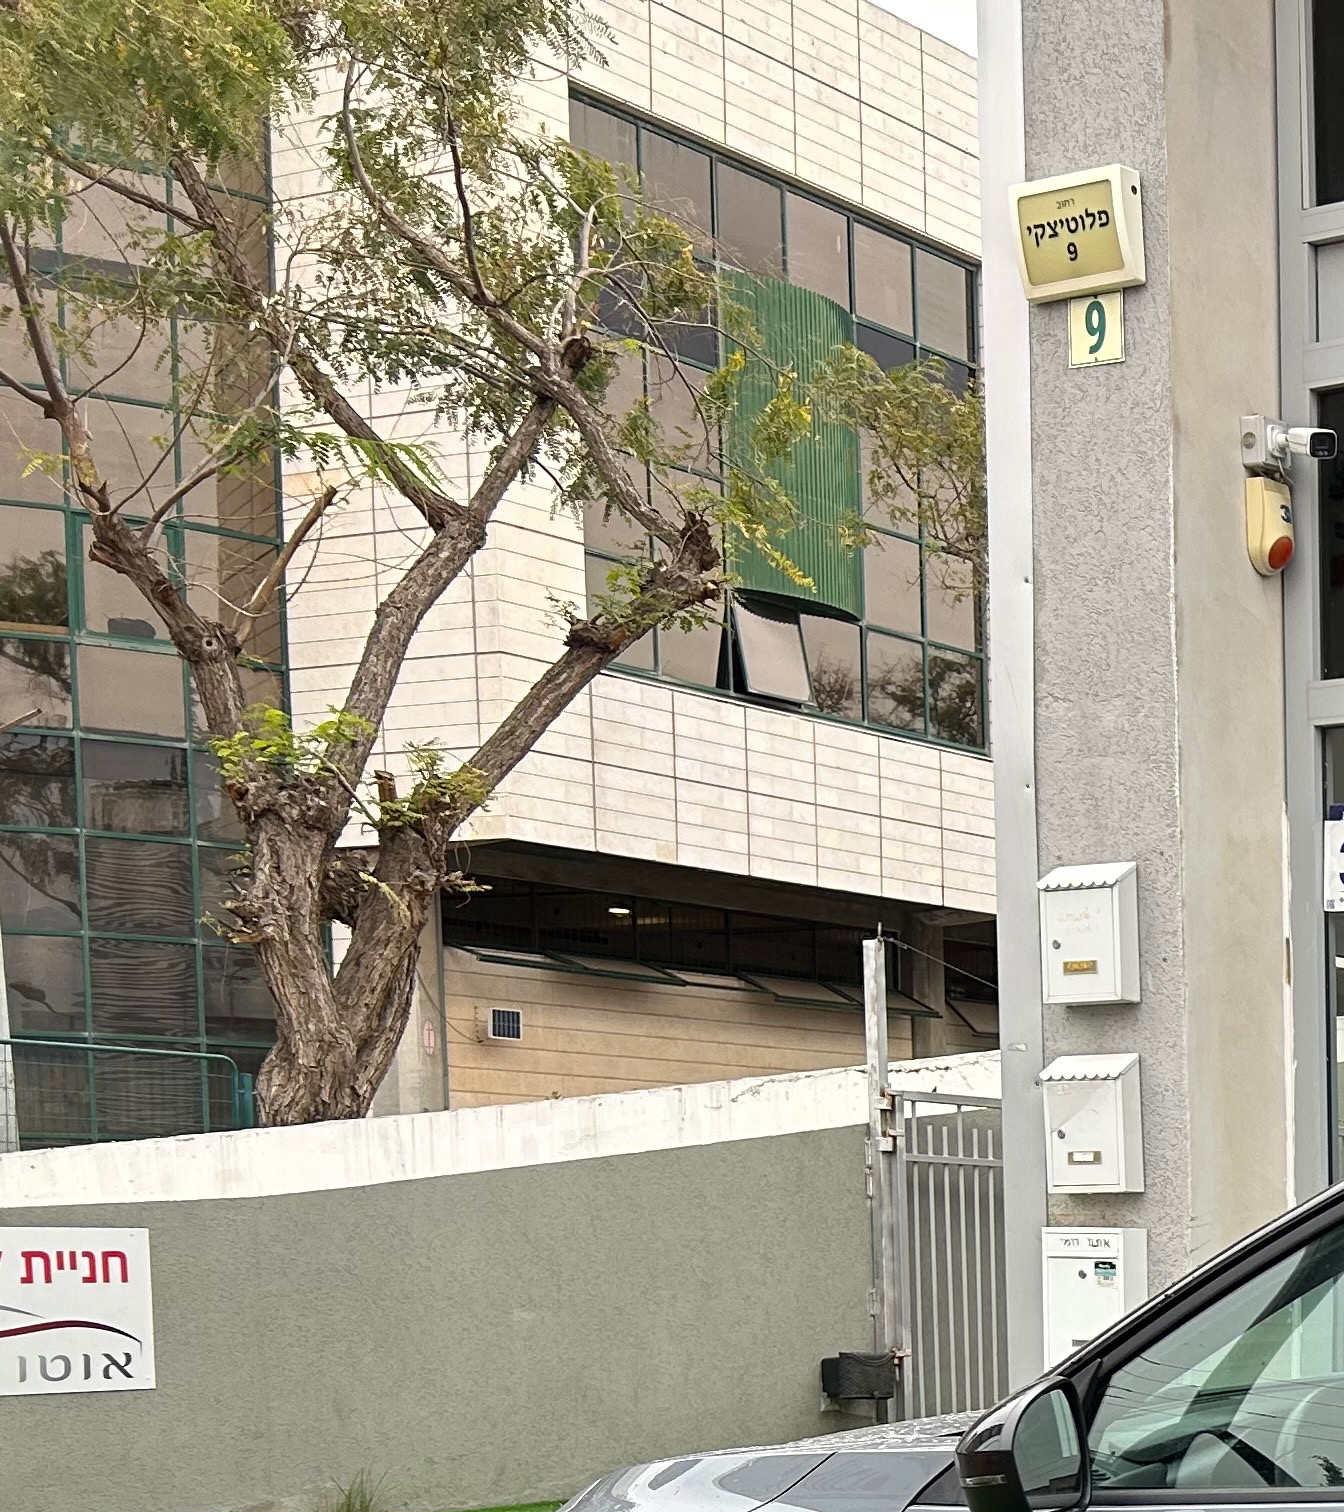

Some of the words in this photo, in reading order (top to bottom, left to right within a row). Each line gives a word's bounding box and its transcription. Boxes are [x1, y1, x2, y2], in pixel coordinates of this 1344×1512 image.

[1026, 206, 1111, 248] פלוטיצקי
[1066, 242, 1079, 262] 9
[1084, 300, 1107, 355] 9
[20, 1250, 129, 1284] חניית
[16, 1352, 135, 1383] אוטו
